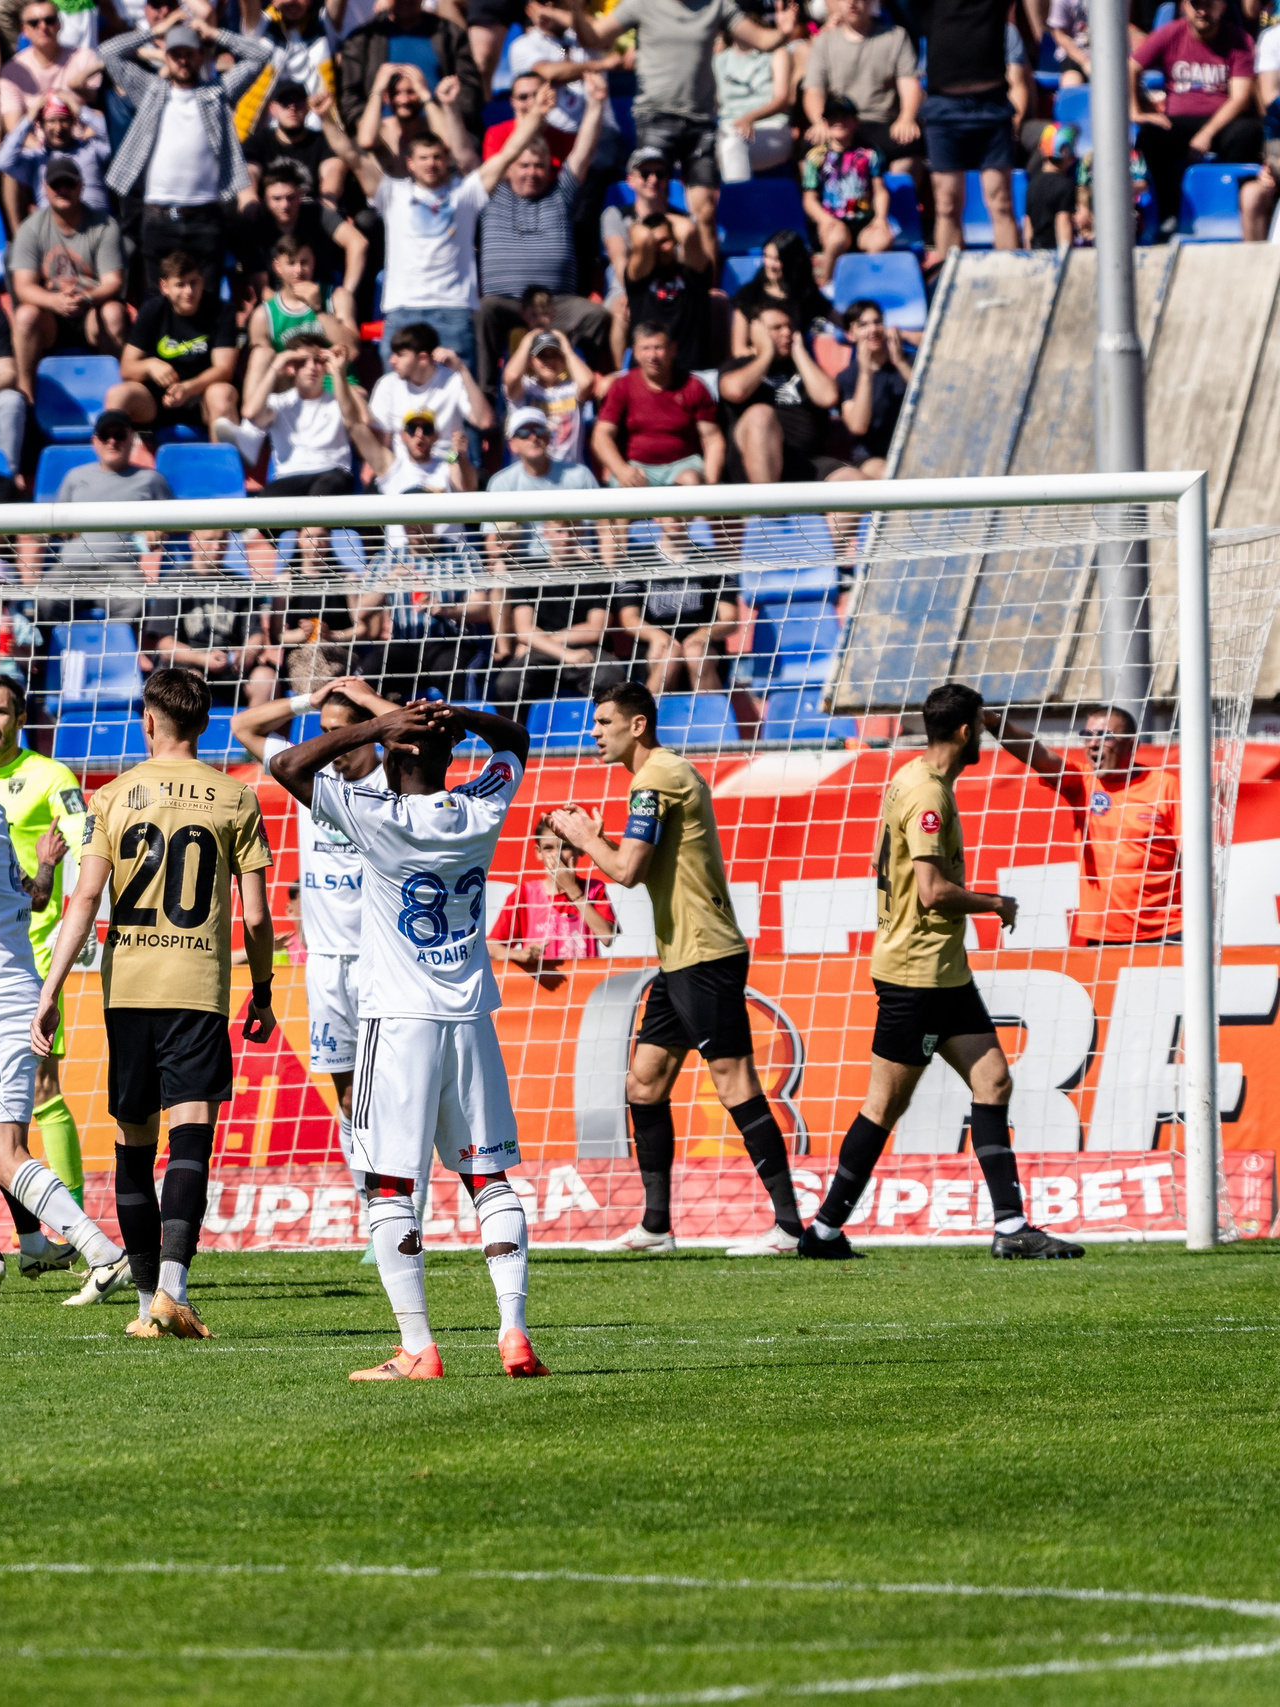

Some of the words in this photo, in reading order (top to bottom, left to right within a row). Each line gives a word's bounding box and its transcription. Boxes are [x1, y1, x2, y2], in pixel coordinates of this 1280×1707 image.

[159, 781, 217, 801] HILS
[112, 822, 218, 929] 20
[136, 934, 214, 952] HOSPITAL
[478, 1142, 503, 1155] Smart
